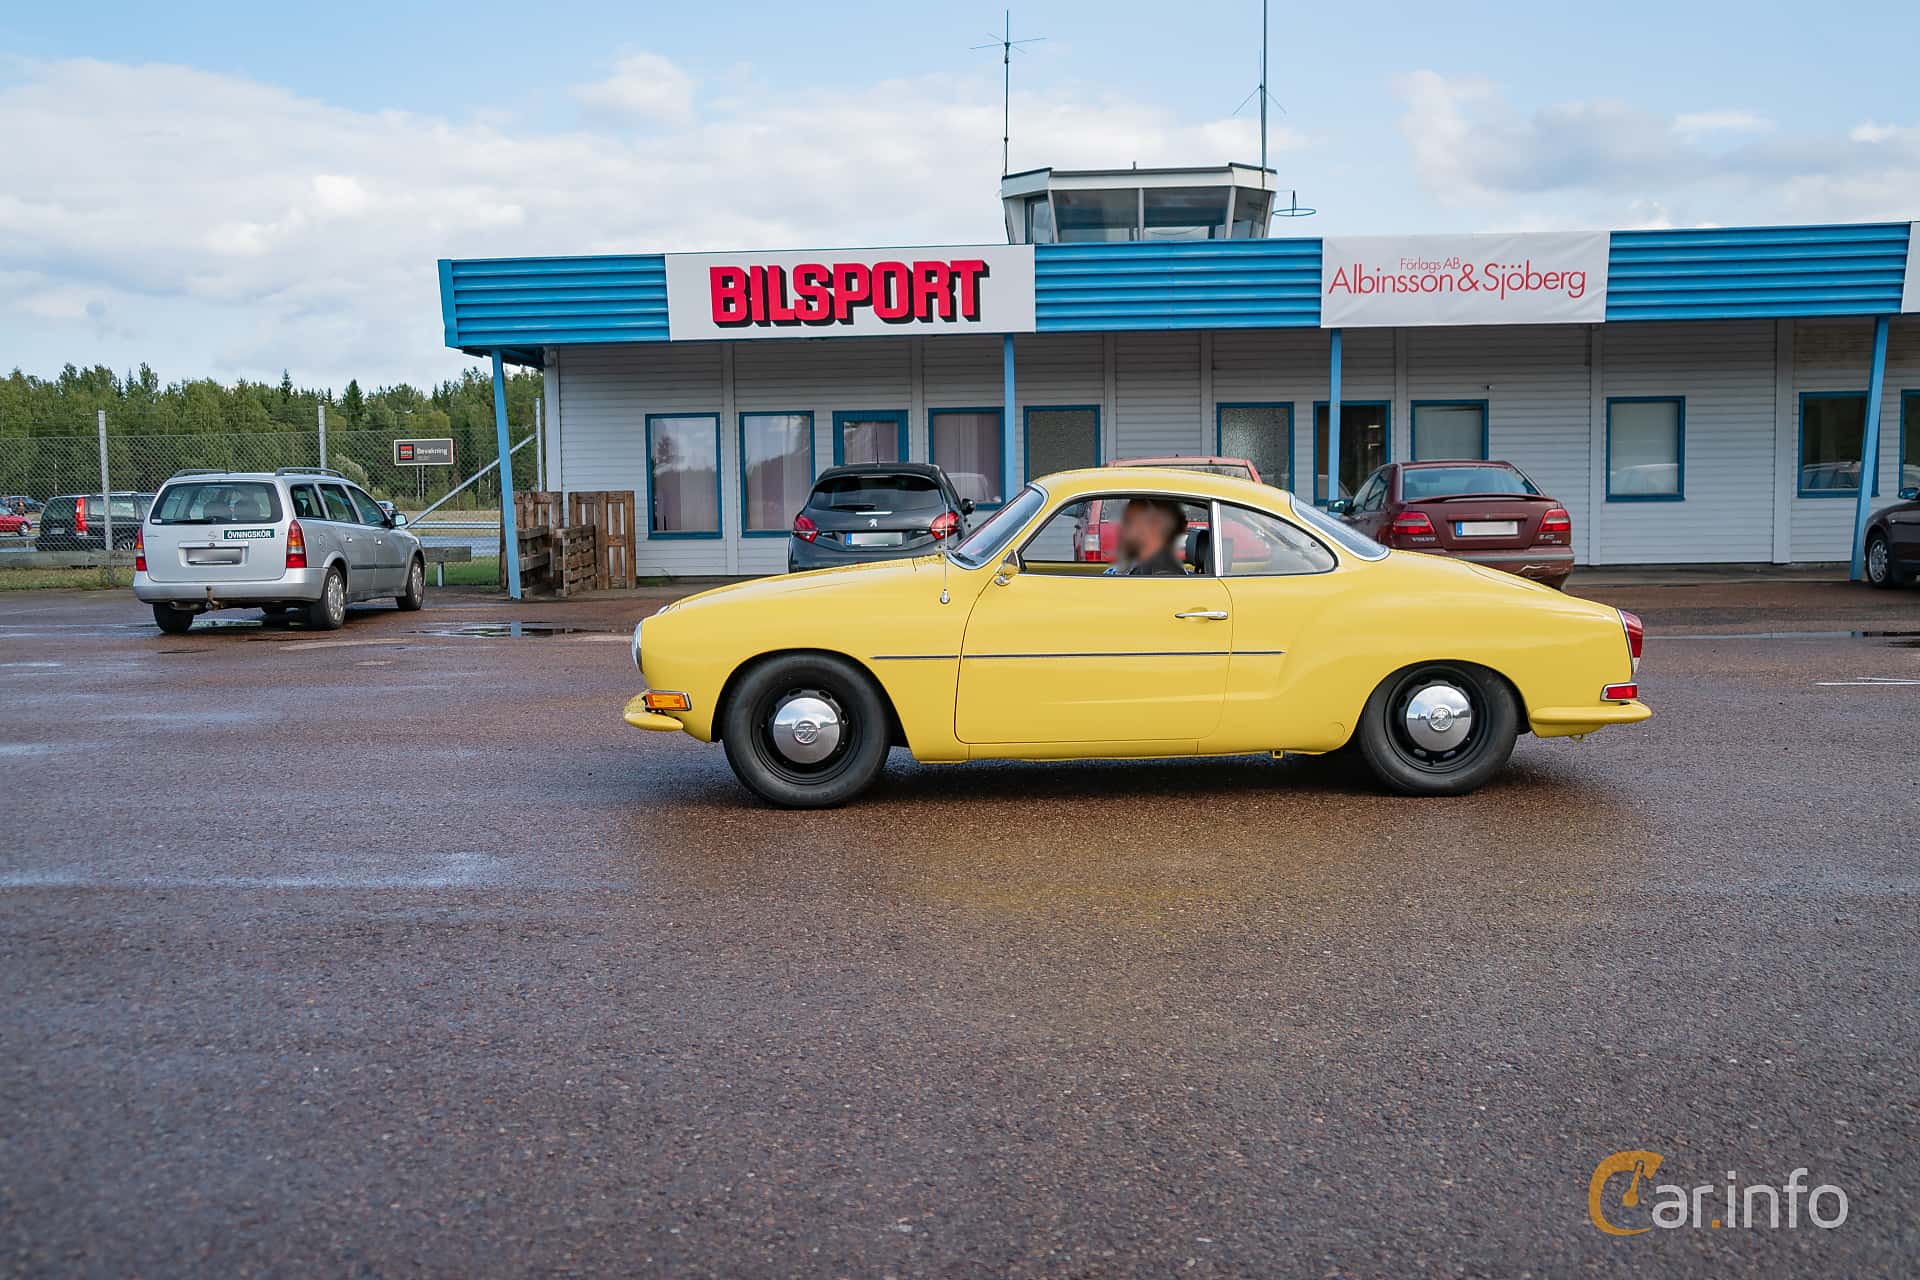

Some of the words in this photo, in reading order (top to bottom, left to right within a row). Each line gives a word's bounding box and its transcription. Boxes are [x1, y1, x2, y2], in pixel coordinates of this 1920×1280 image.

[1400, 256, 1442, 273] Förlags
[1443, 257, 1461, 270] AB
[710, 259, 989, 328] BILSPORT
[1328, 263, 1454, 295] Albinsson
[1482, 259, 1586, 301] Sjöberg
[227, 529, 272, 539] ÖVNINGSKÖR
